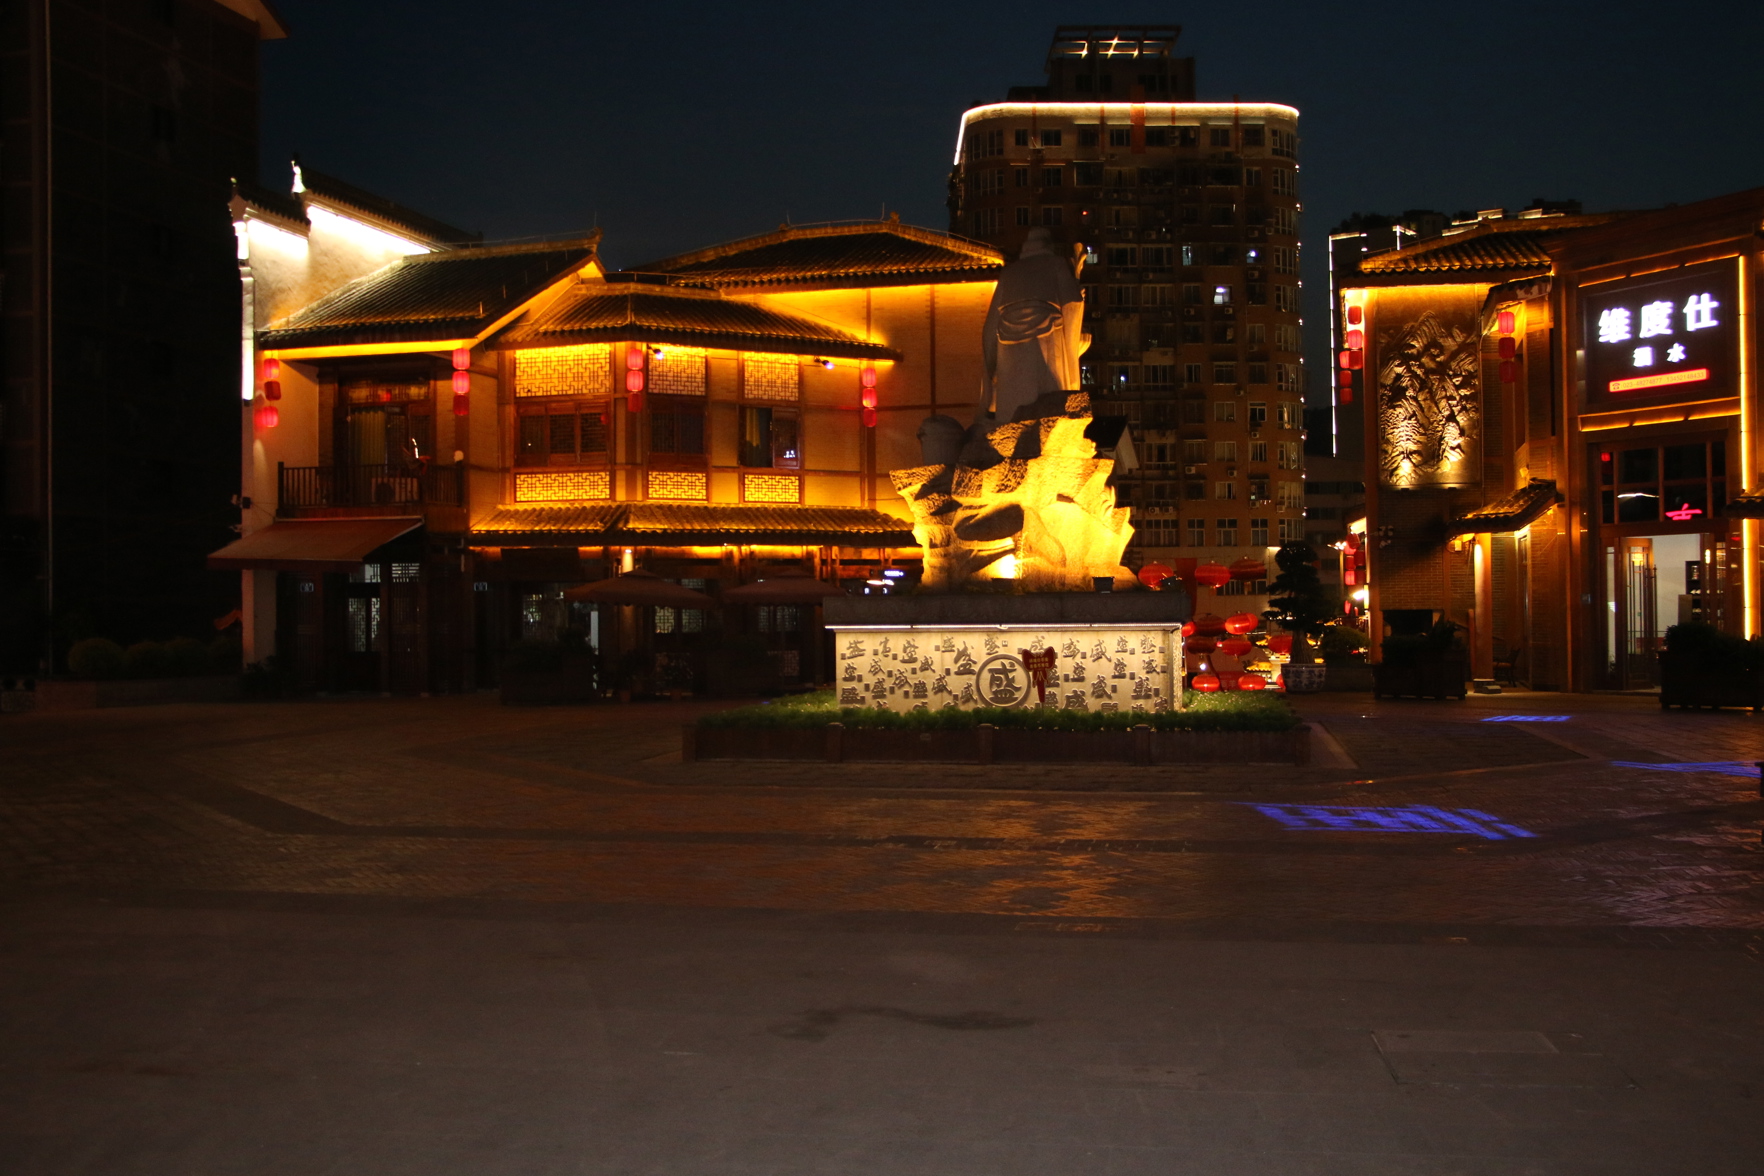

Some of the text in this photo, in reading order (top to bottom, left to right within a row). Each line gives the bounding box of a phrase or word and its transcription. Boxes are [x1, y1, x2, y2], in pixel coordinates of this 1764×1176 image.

[1598, 292, 1720, 344] 维度仕
[986, 661, 1022, 705] 盛
